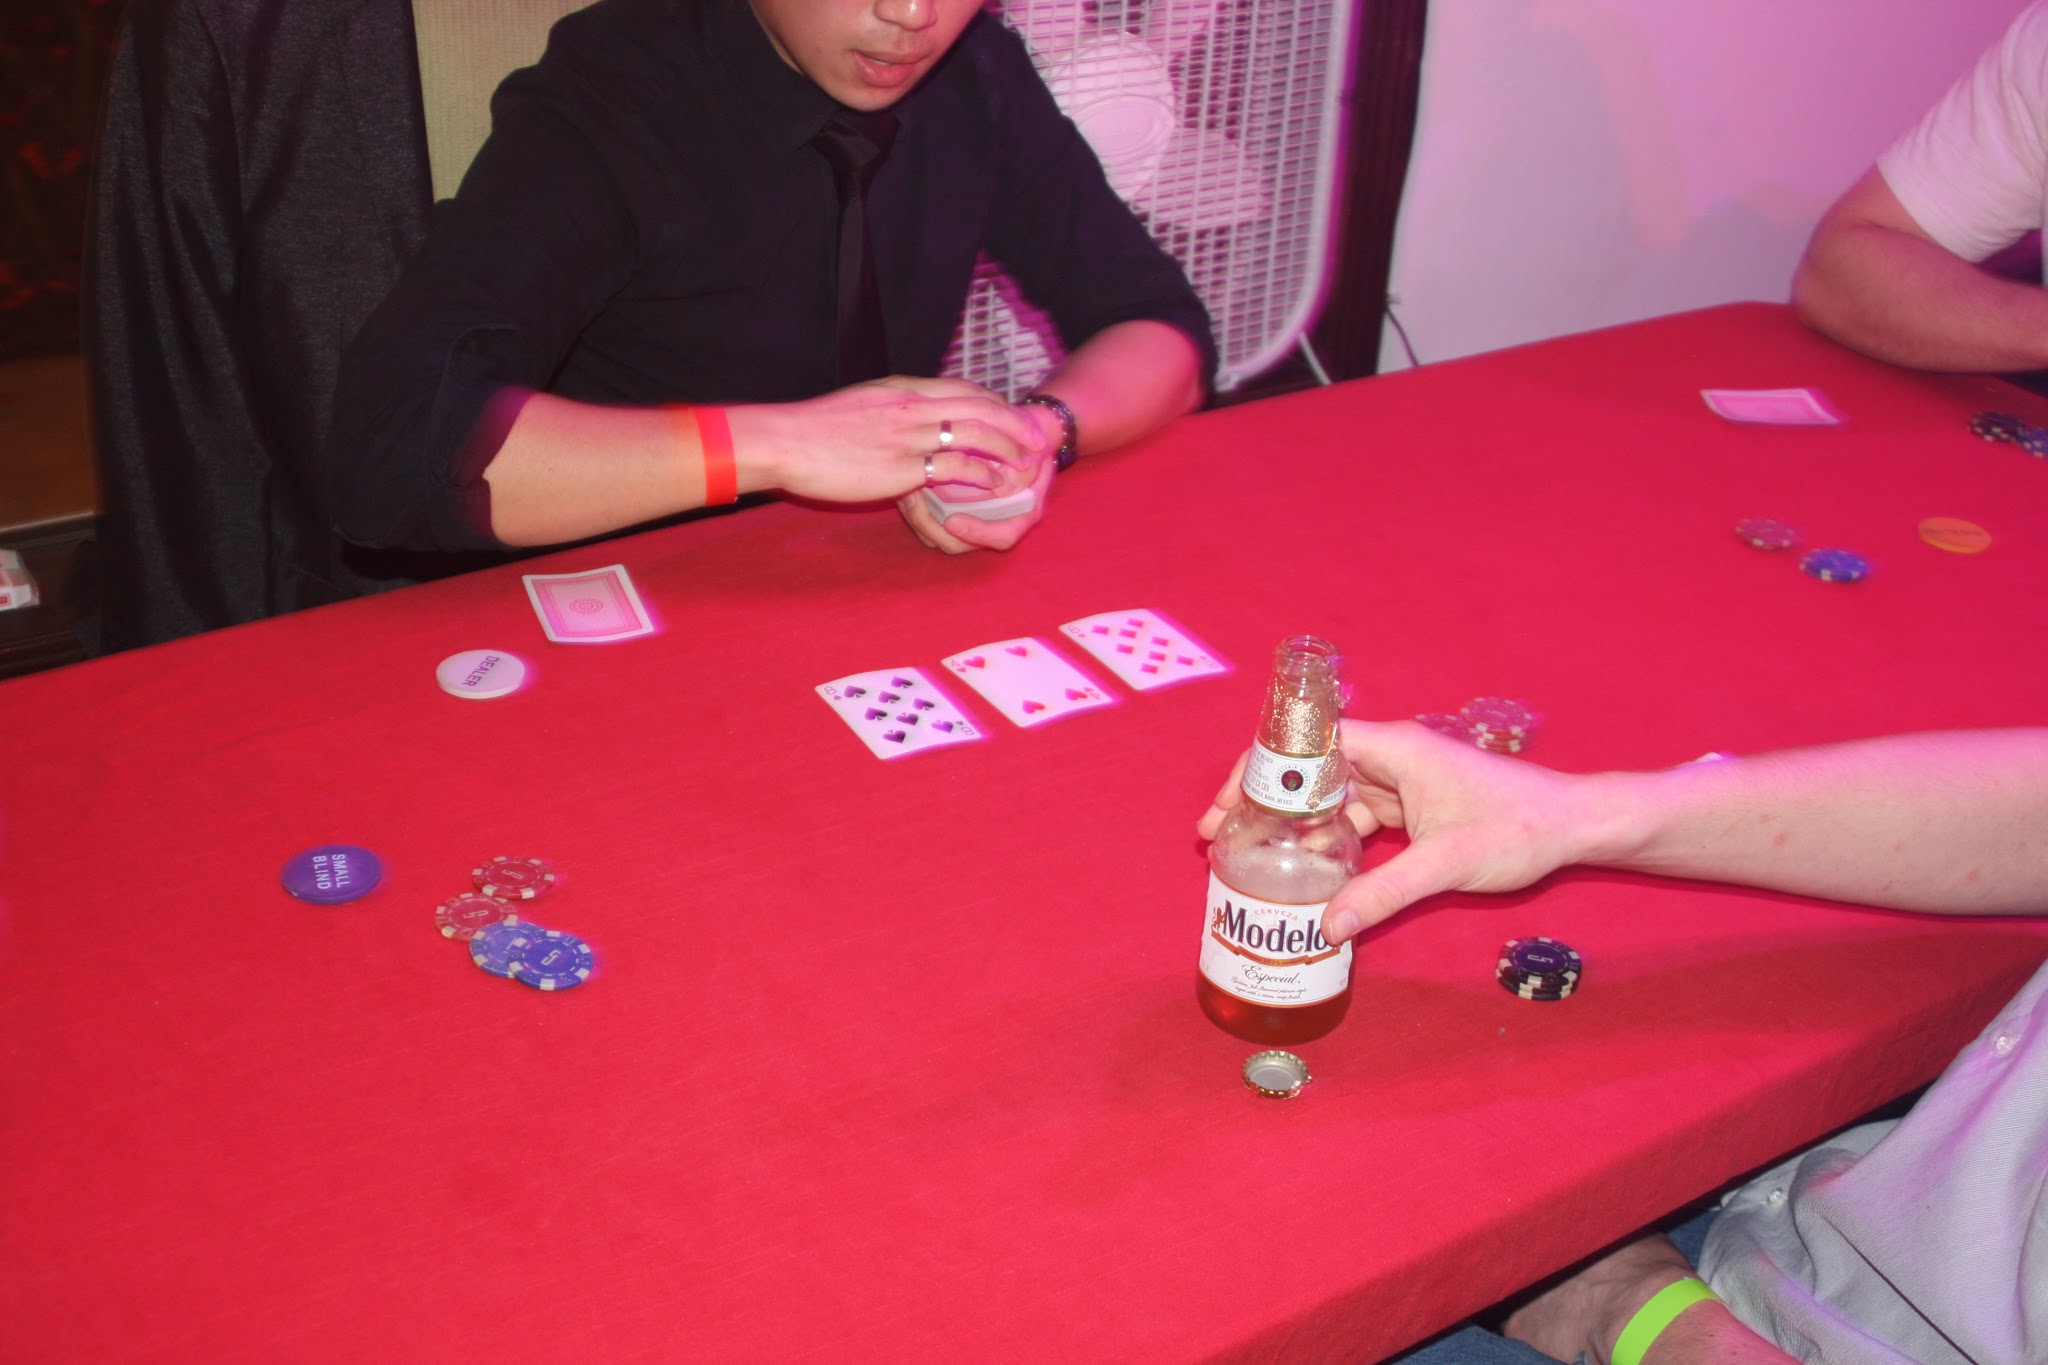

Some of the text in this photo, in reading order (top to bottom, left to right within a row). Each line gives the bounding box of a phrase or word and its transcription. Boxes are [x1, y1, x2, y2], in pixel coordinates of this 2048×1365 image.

[461, 655, 500, 687] DEALER
[312, 855, 331, 890] BLIND
[332, 853, 350, 888] SMALL
[1254, 908, 1298, 921] CERVEZA
